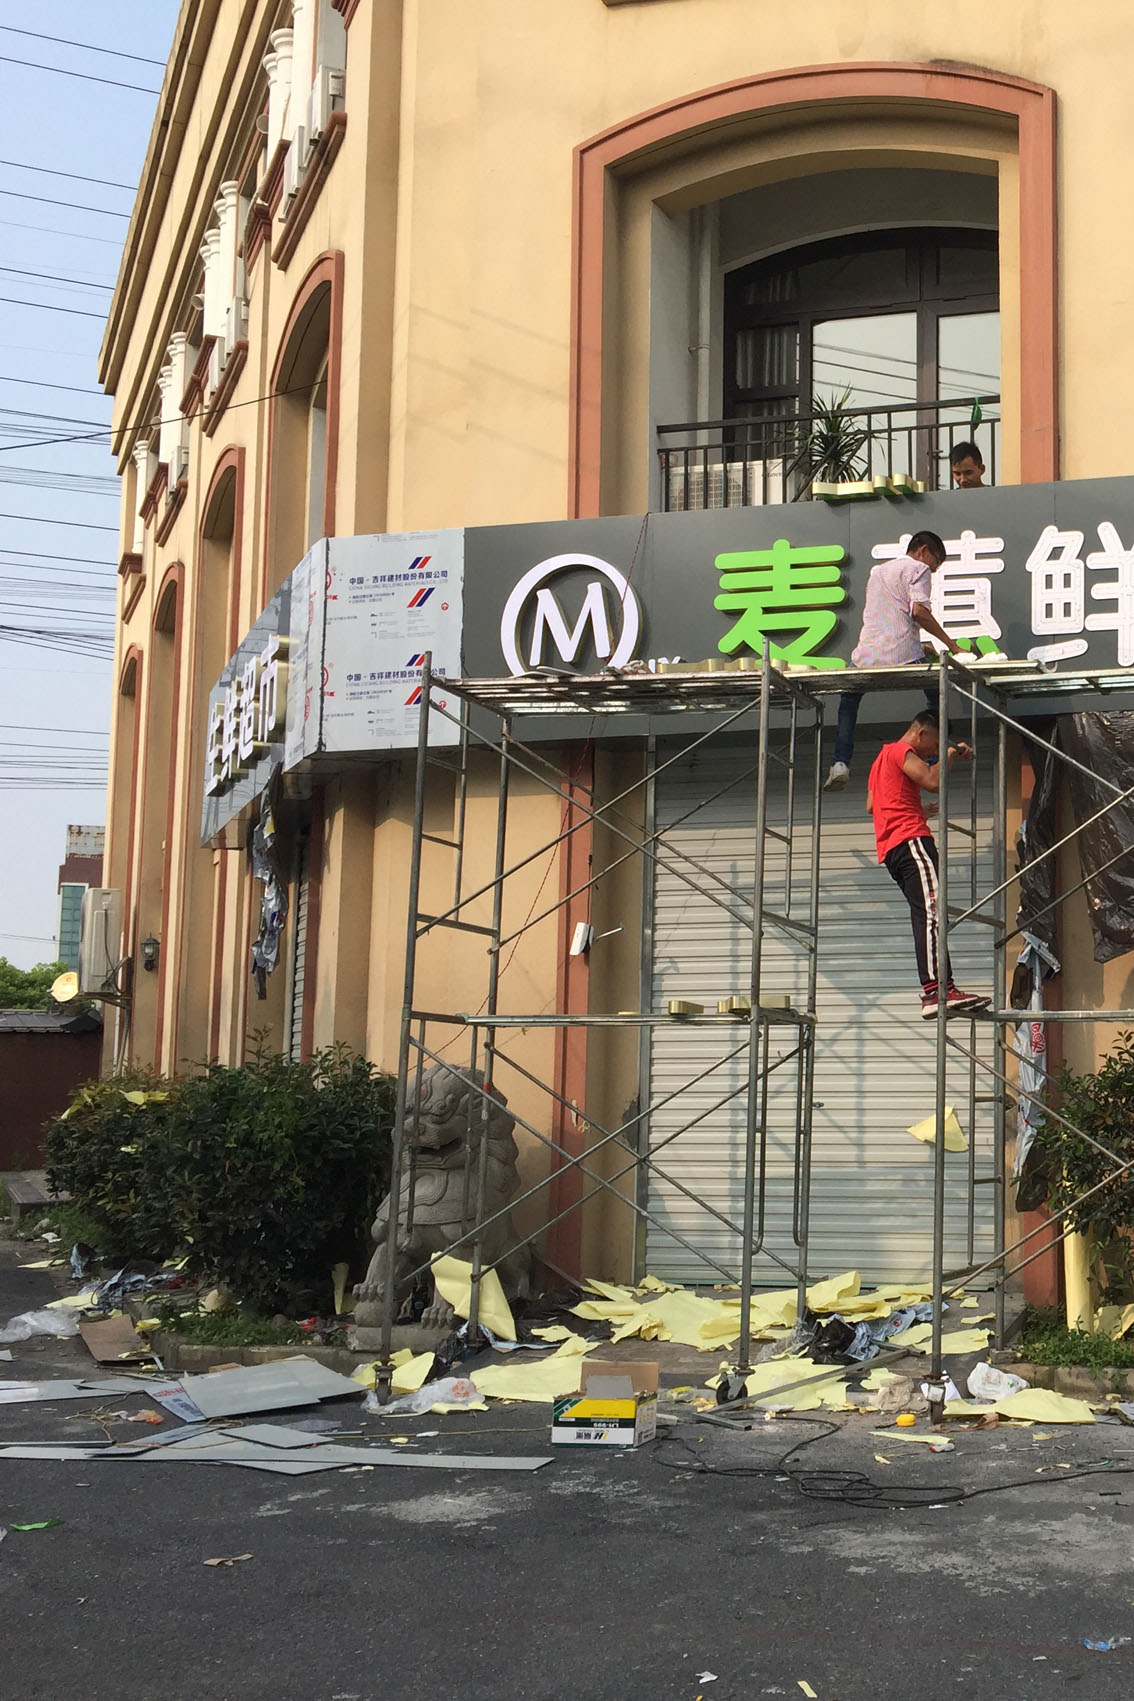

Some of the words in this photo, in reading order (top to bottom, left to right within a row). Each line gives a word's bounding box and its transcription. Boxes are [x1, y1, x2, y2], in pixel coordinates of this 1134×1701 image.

[530, 582, 611, 667] M
[346, 667, 446, 681] 中国·吉祥建材股份有公司
